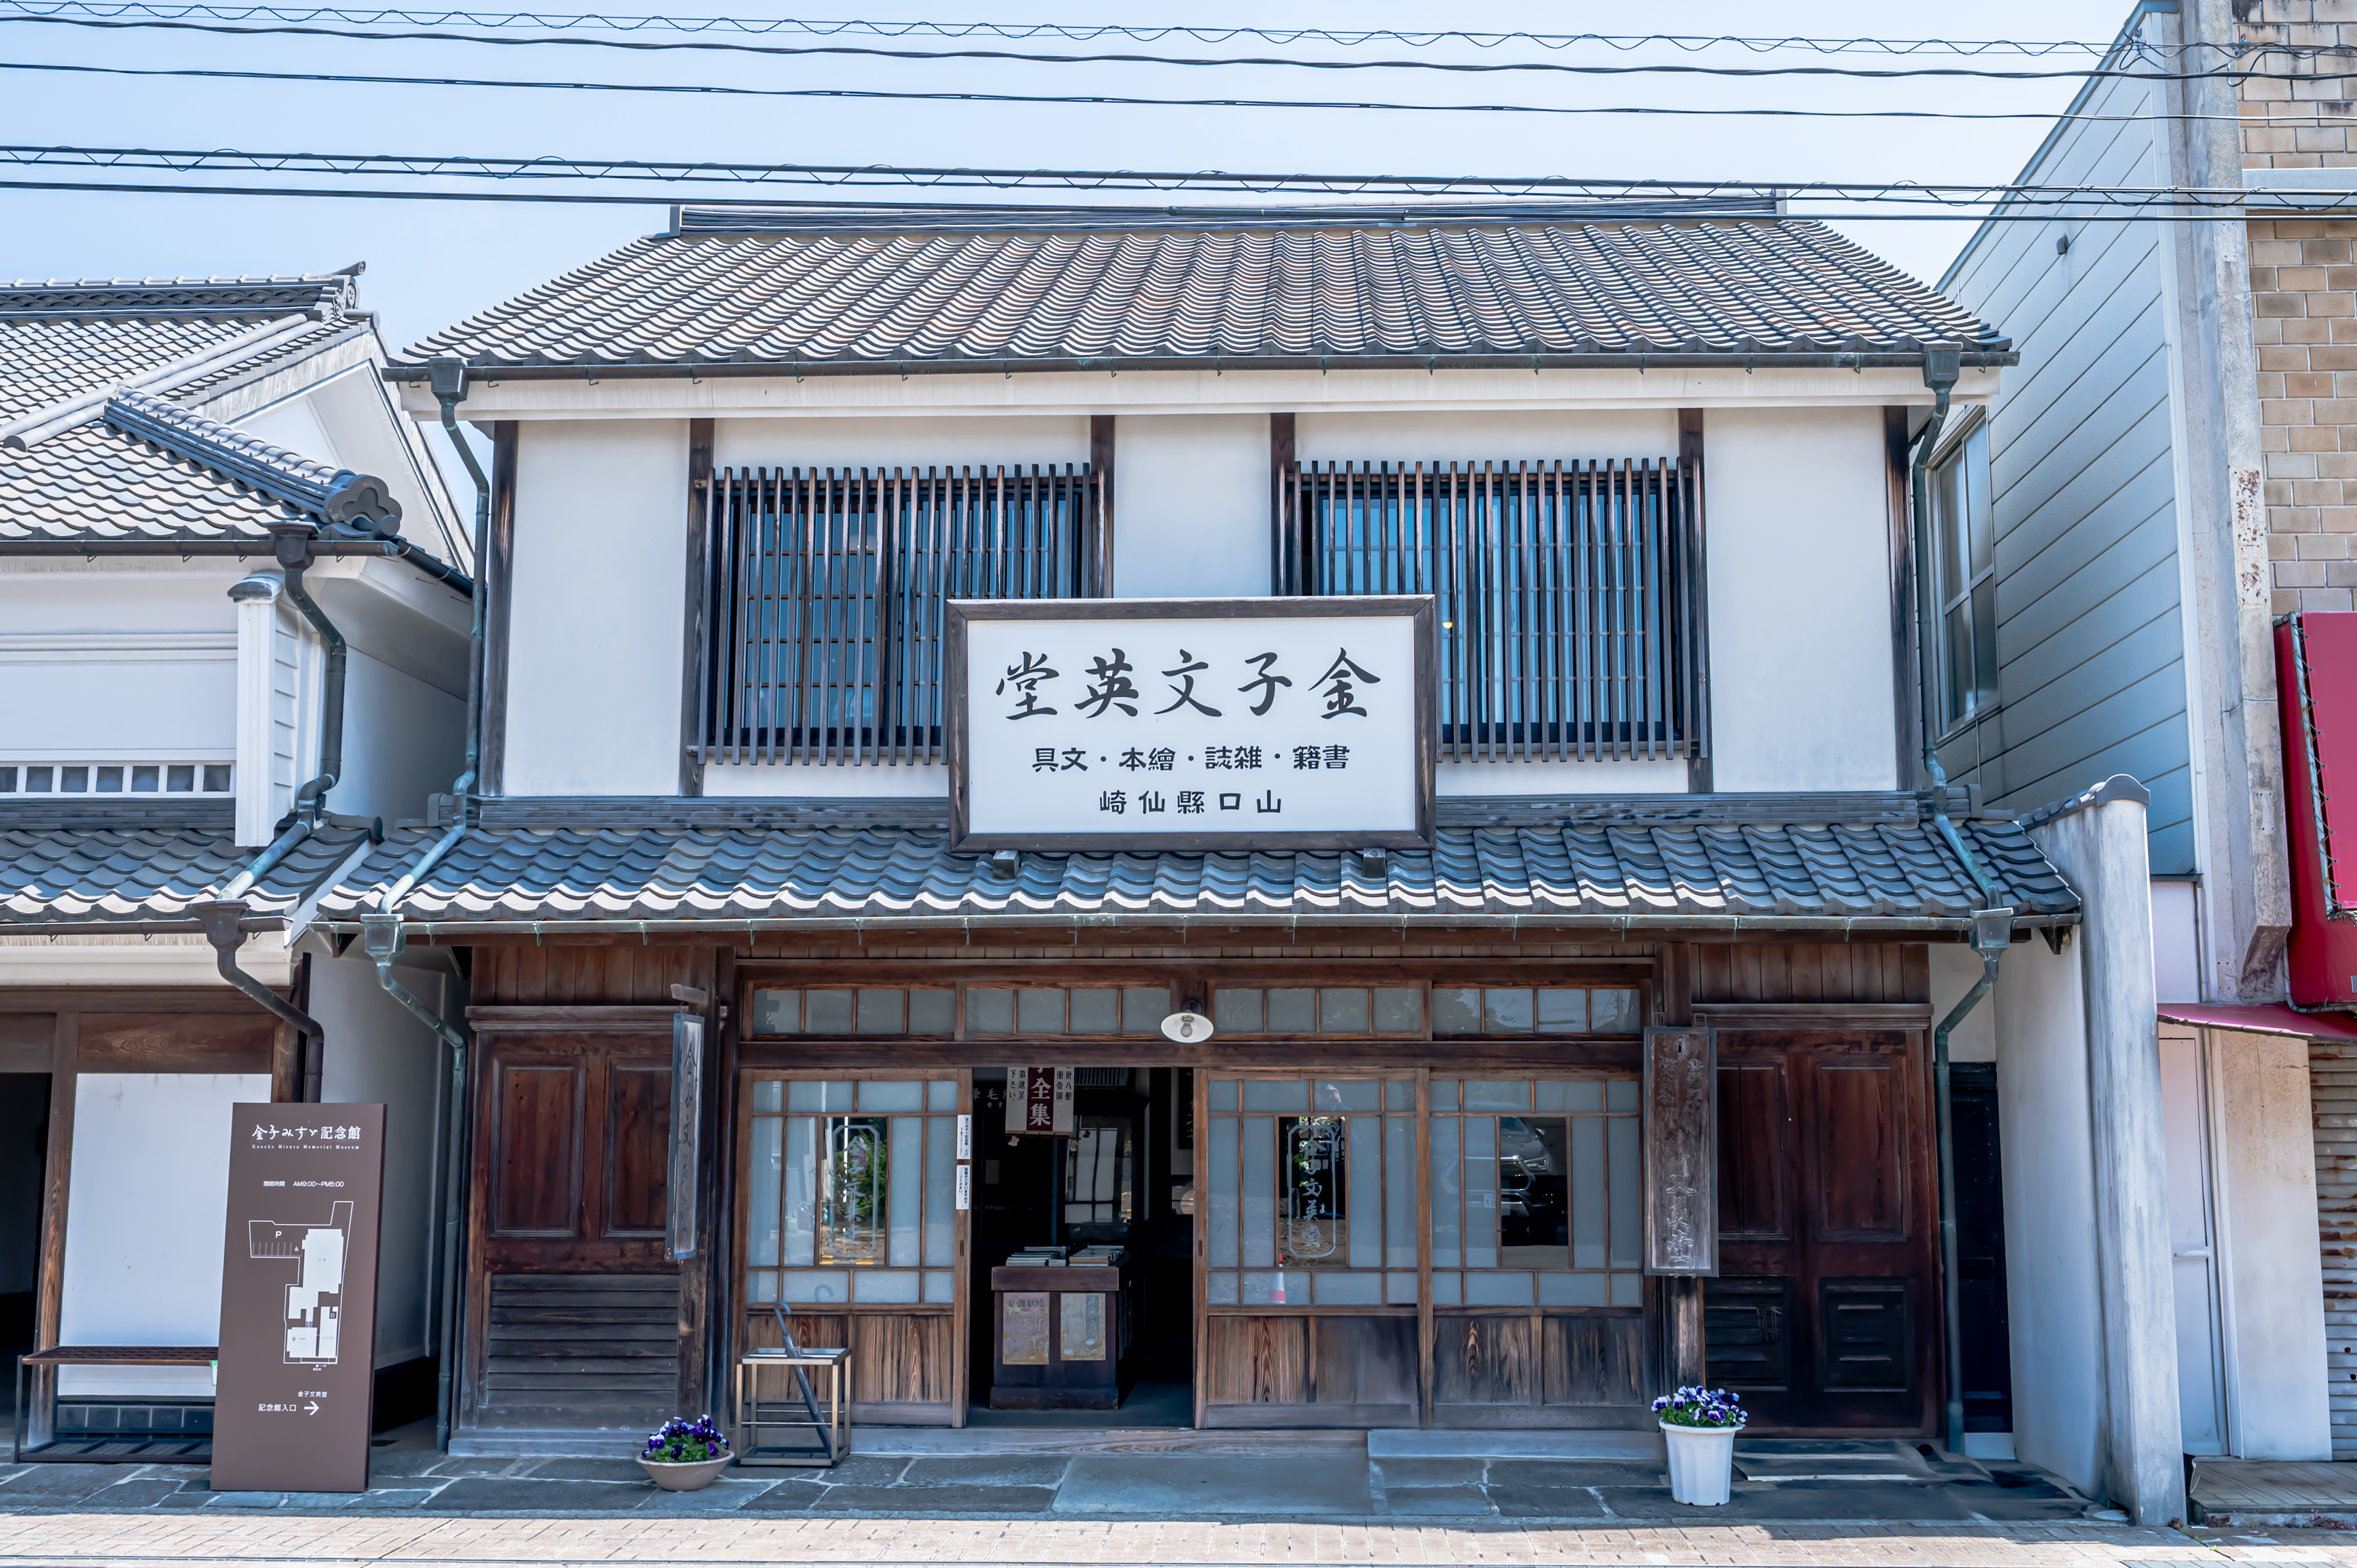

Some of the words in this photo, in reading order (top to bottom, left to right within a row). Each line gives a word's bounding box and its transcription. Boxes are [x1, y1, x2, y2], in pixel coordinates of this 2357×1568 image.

[995, 646, 1382, 721] 金子文英堂
[251, 1123, 362, 1140] 金子みすゞ記念館
[275, 1230, 282, 1238] P
[258, 1404, 297, 1412] 記念館入口
